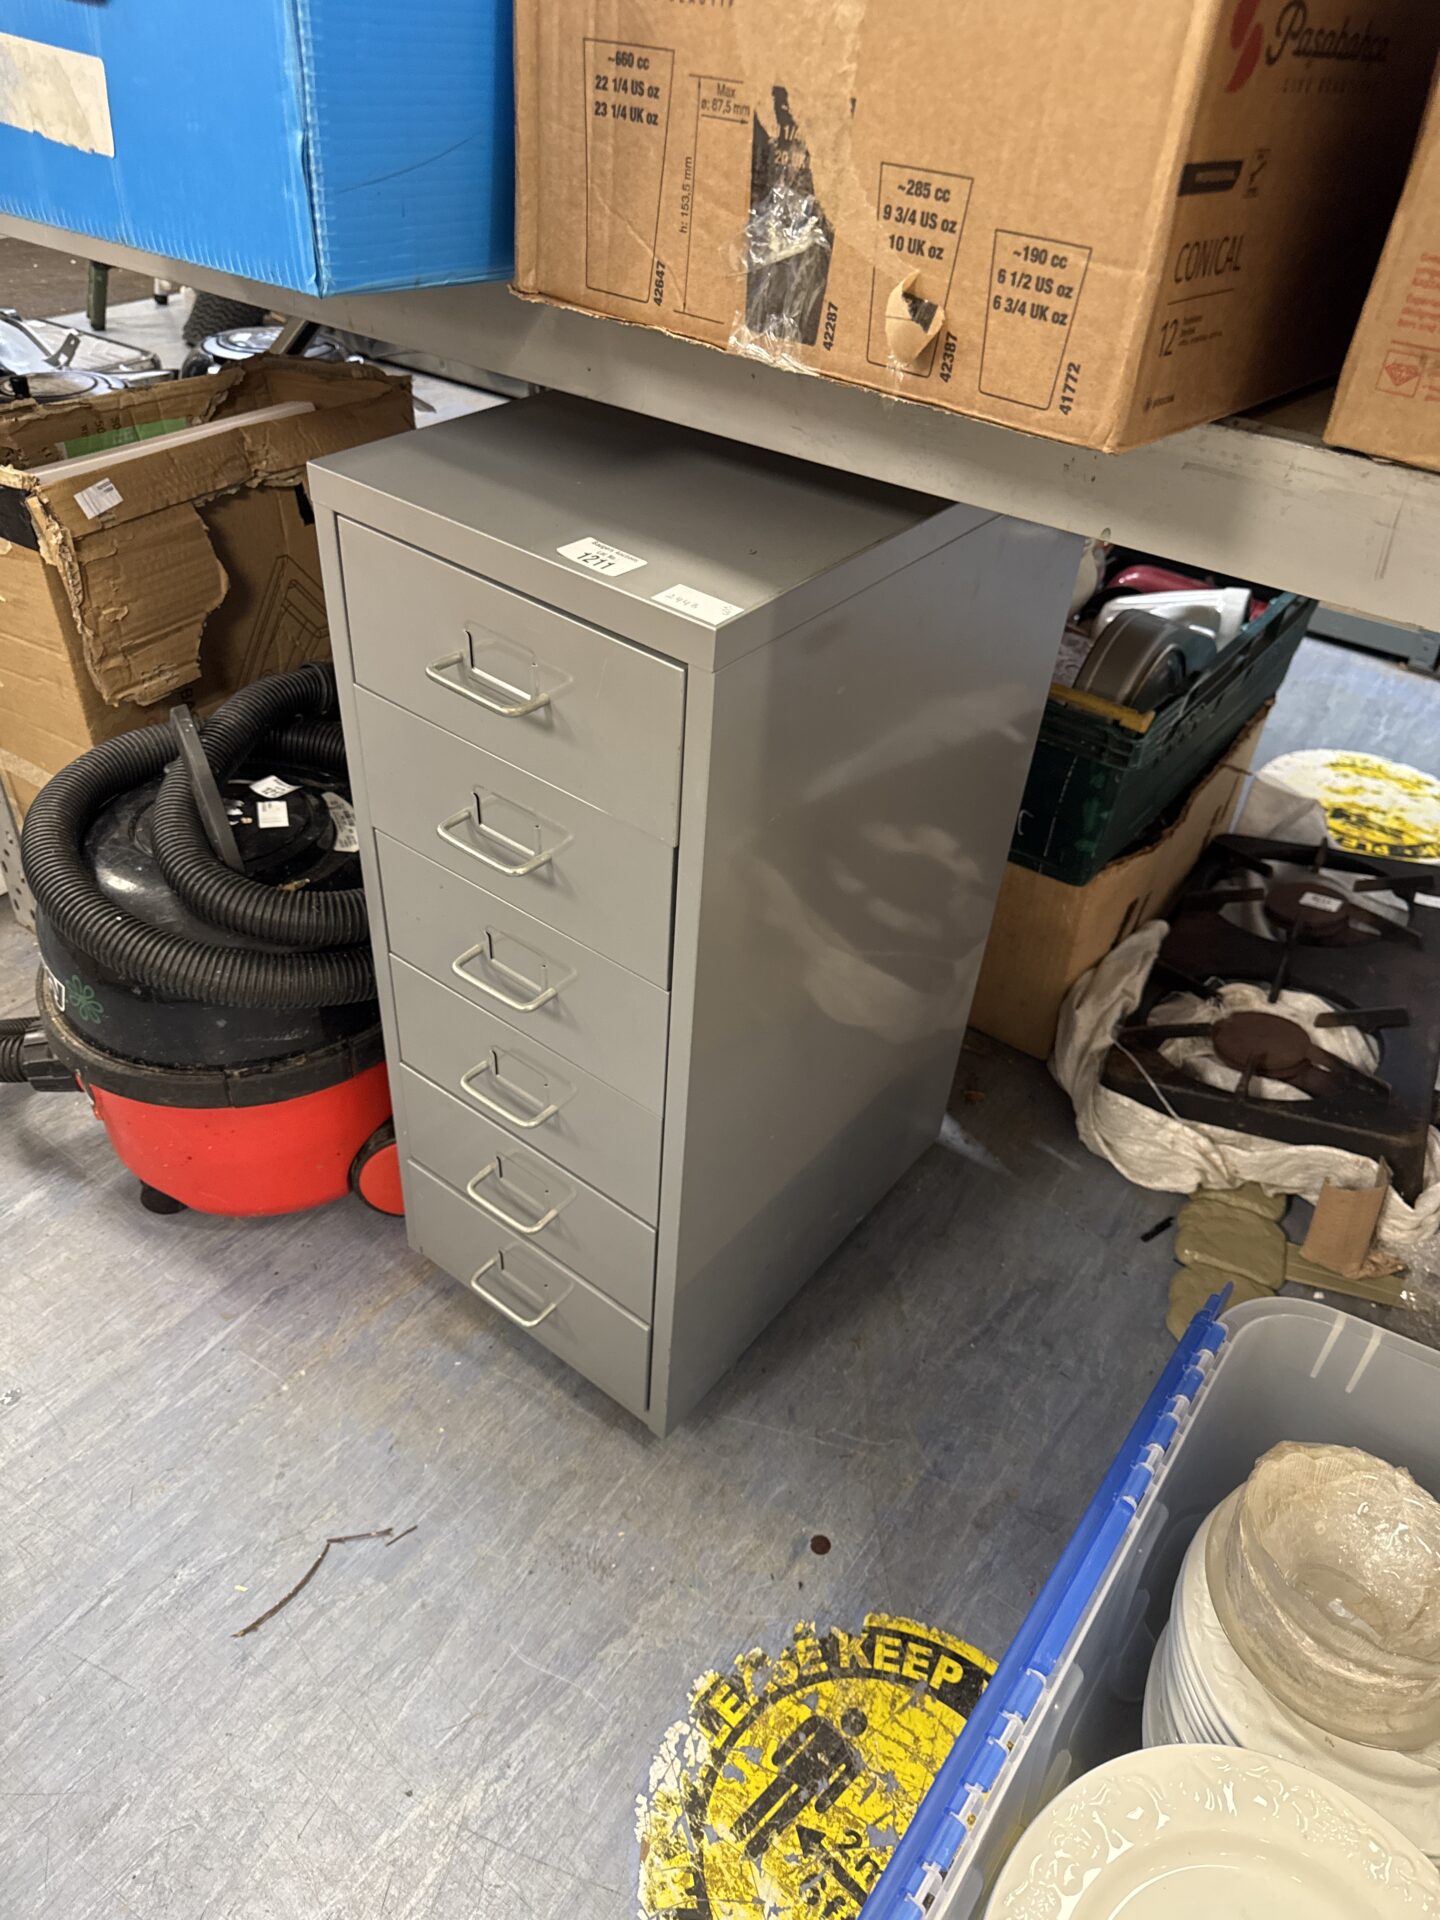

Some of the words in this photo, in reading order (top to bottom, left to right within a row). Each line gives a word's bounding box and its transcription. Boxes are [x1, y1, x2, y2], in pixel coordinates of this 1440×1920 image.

[608, 50, 634, 68] ~660
[637, 57, 650, 70] cc
[595, 74, 609, 91] 22
[612, 76, 628, 94] 1/4
[631, 79, 645, 97] US
[647, 85, 660, 99] oz
[716, 82, 736, 99] Max
[594, 100, 607, 117] 23
[611, 103, 627, 120] 1/4
[630, 106, 644, 124] UK
[646, 112, 658, 126] oz
[733, 103, 750, 116] mm
[685, 156, 692, 180] mm
[897, 179, 931, 199] ~285
[934, 187, 951, 203] cc
[883, 204, 892, 220] 9
[894, 206, 917, 226] 3/4
[920, 211, 938, 230] US
[940, 218, 957, 234] oz
[889, 234, 905, 252] 10
[907, 237, 926, 257] UK
[928, 246, 944, 260] oz
[1012, 245, 1048, 265] ~190
[1050, 254, 1068, 270] cc
[1174, 235, 1245, 284] CONICAL
[653, 261, 666, 307] 42647
[997, 268, 1007, 284] 6
[1011, 271, 1032, 290] 1/2
[1035, 275, 1054, 294] US
[1056, 284, 1073, 299] oz
[993, 294, 1002, 310] 6
[1004, 297, 1027, 317] 3/4
[1030, 302, 1050, 322] UK
[1051, 311, 1068, 326] oz
[822, 302, 839, 351] 42287
[1158, 318, 1179, 358] 12
[939, 331, 958, 383] 42387
[1059, 361, 1081, 416] 41772
[577, 552, 616, 569] 1211
[836, 1630, 964, 1690] KEEP
